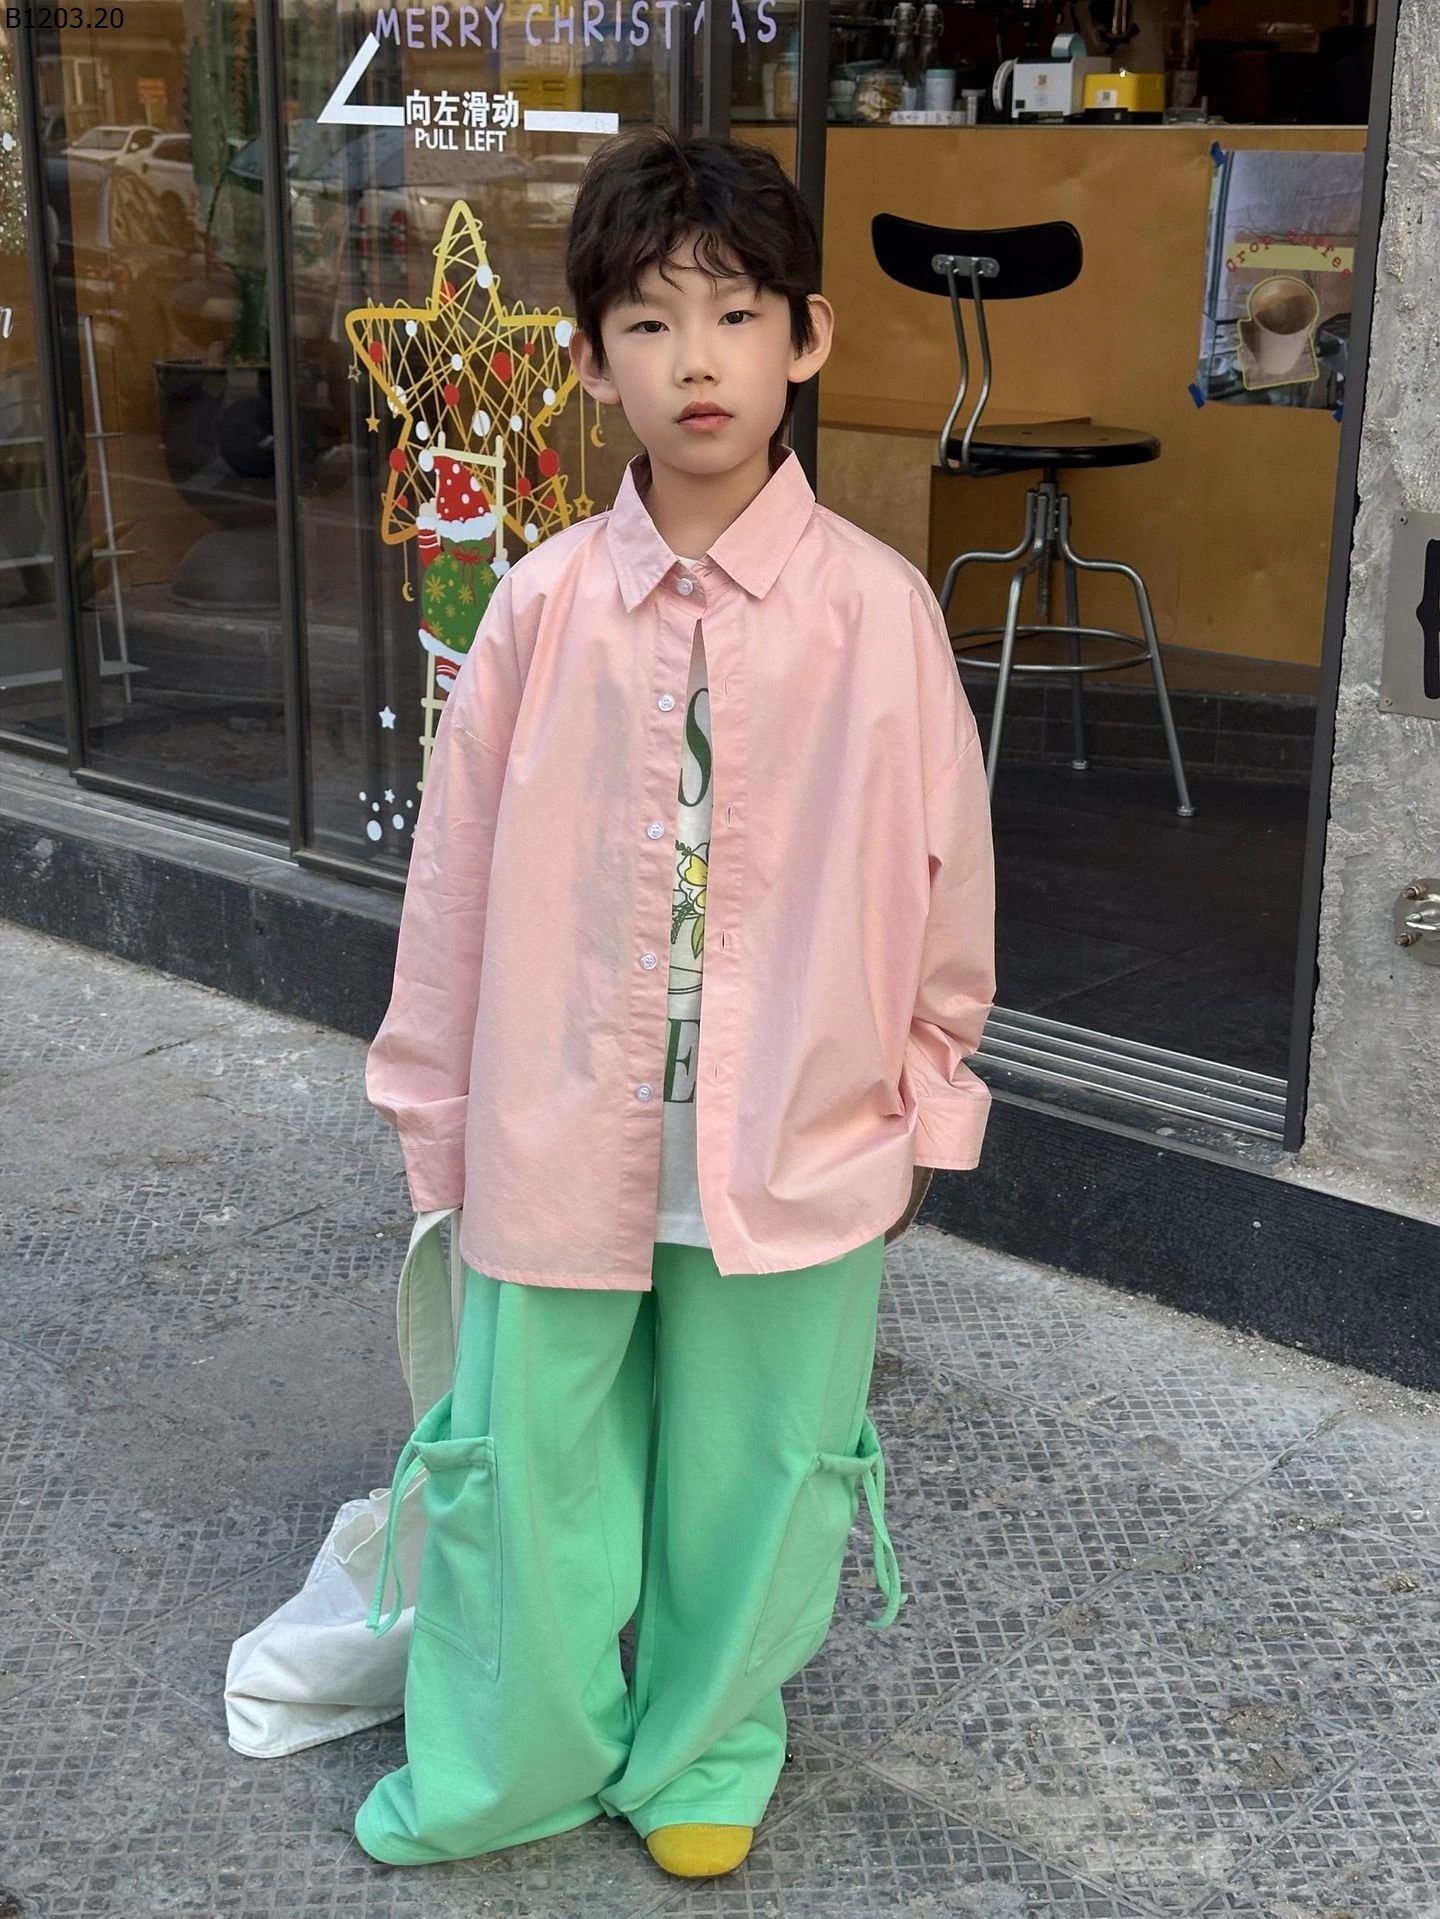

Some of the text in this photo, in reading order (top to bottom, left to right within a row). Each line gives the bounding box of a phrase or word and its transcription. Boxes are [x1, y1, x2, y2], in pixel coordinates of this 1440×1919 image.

[375, 4, 504, 49] MERRY
[406, 89, 519, 128] 向左滑动
[415, 128, 507, 152] PULL LEFT
